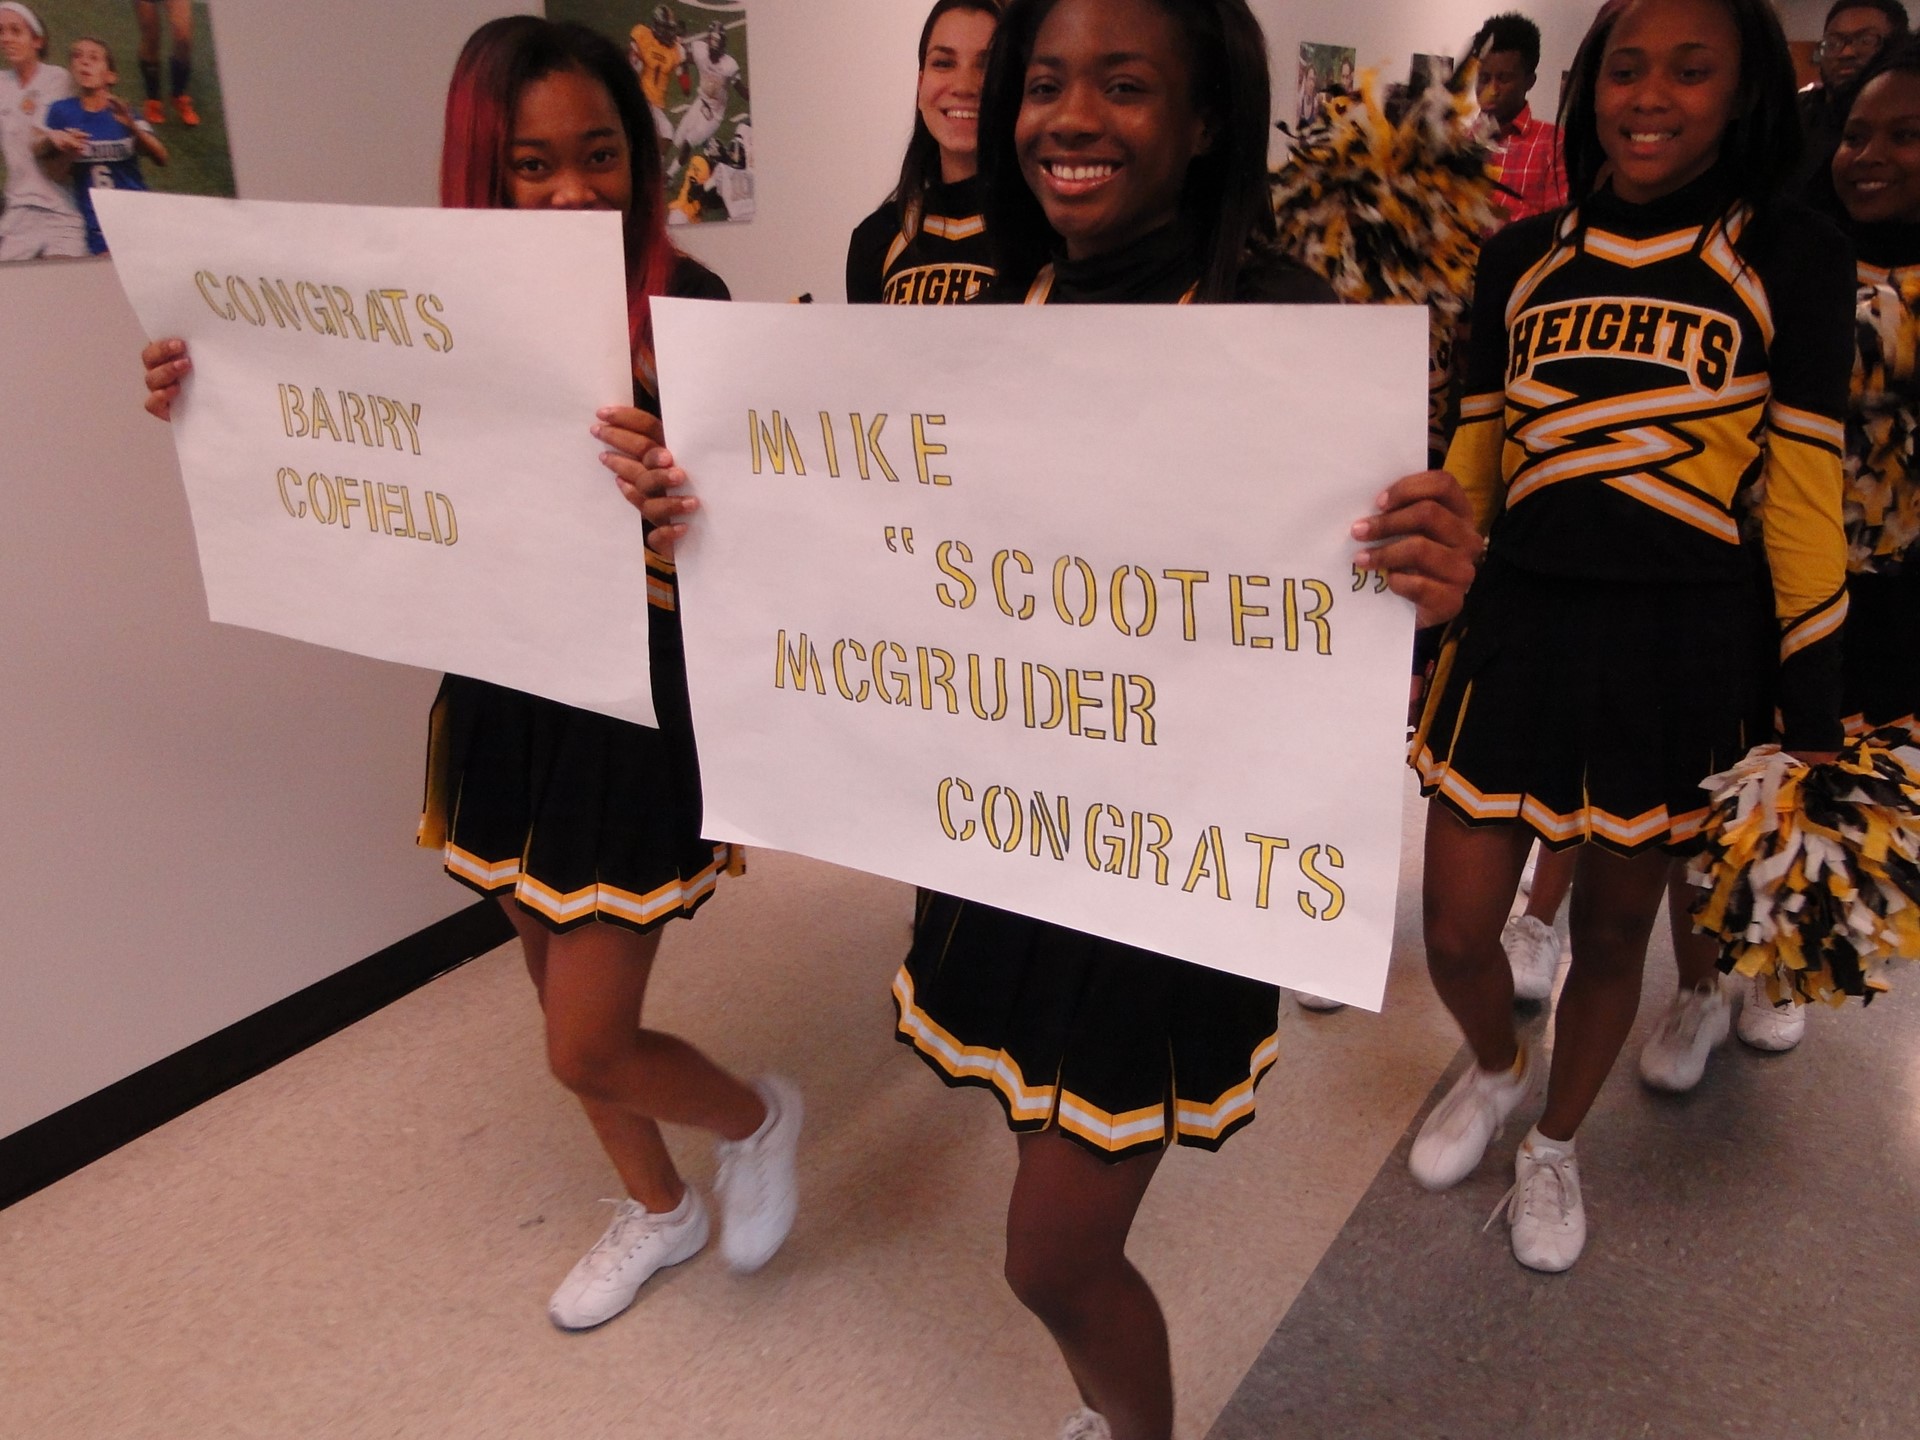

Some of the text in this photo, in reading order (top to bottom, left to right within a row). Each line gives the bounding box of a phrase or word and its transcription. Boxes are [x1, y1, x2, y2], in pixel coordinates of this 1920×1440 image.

[194, 269, 454, 353] CONGRATS
[1508, 300, 1737, 394] HEIGHTS
[277, 382, 422, 456] BARRY
[748, 409, 953, 486] MIKE
[276, 466, 459, 546] COFIELD
[774, 629, 1158, 745] MCGRUDER
[937, 776, 1346, 921] CONGRATS
